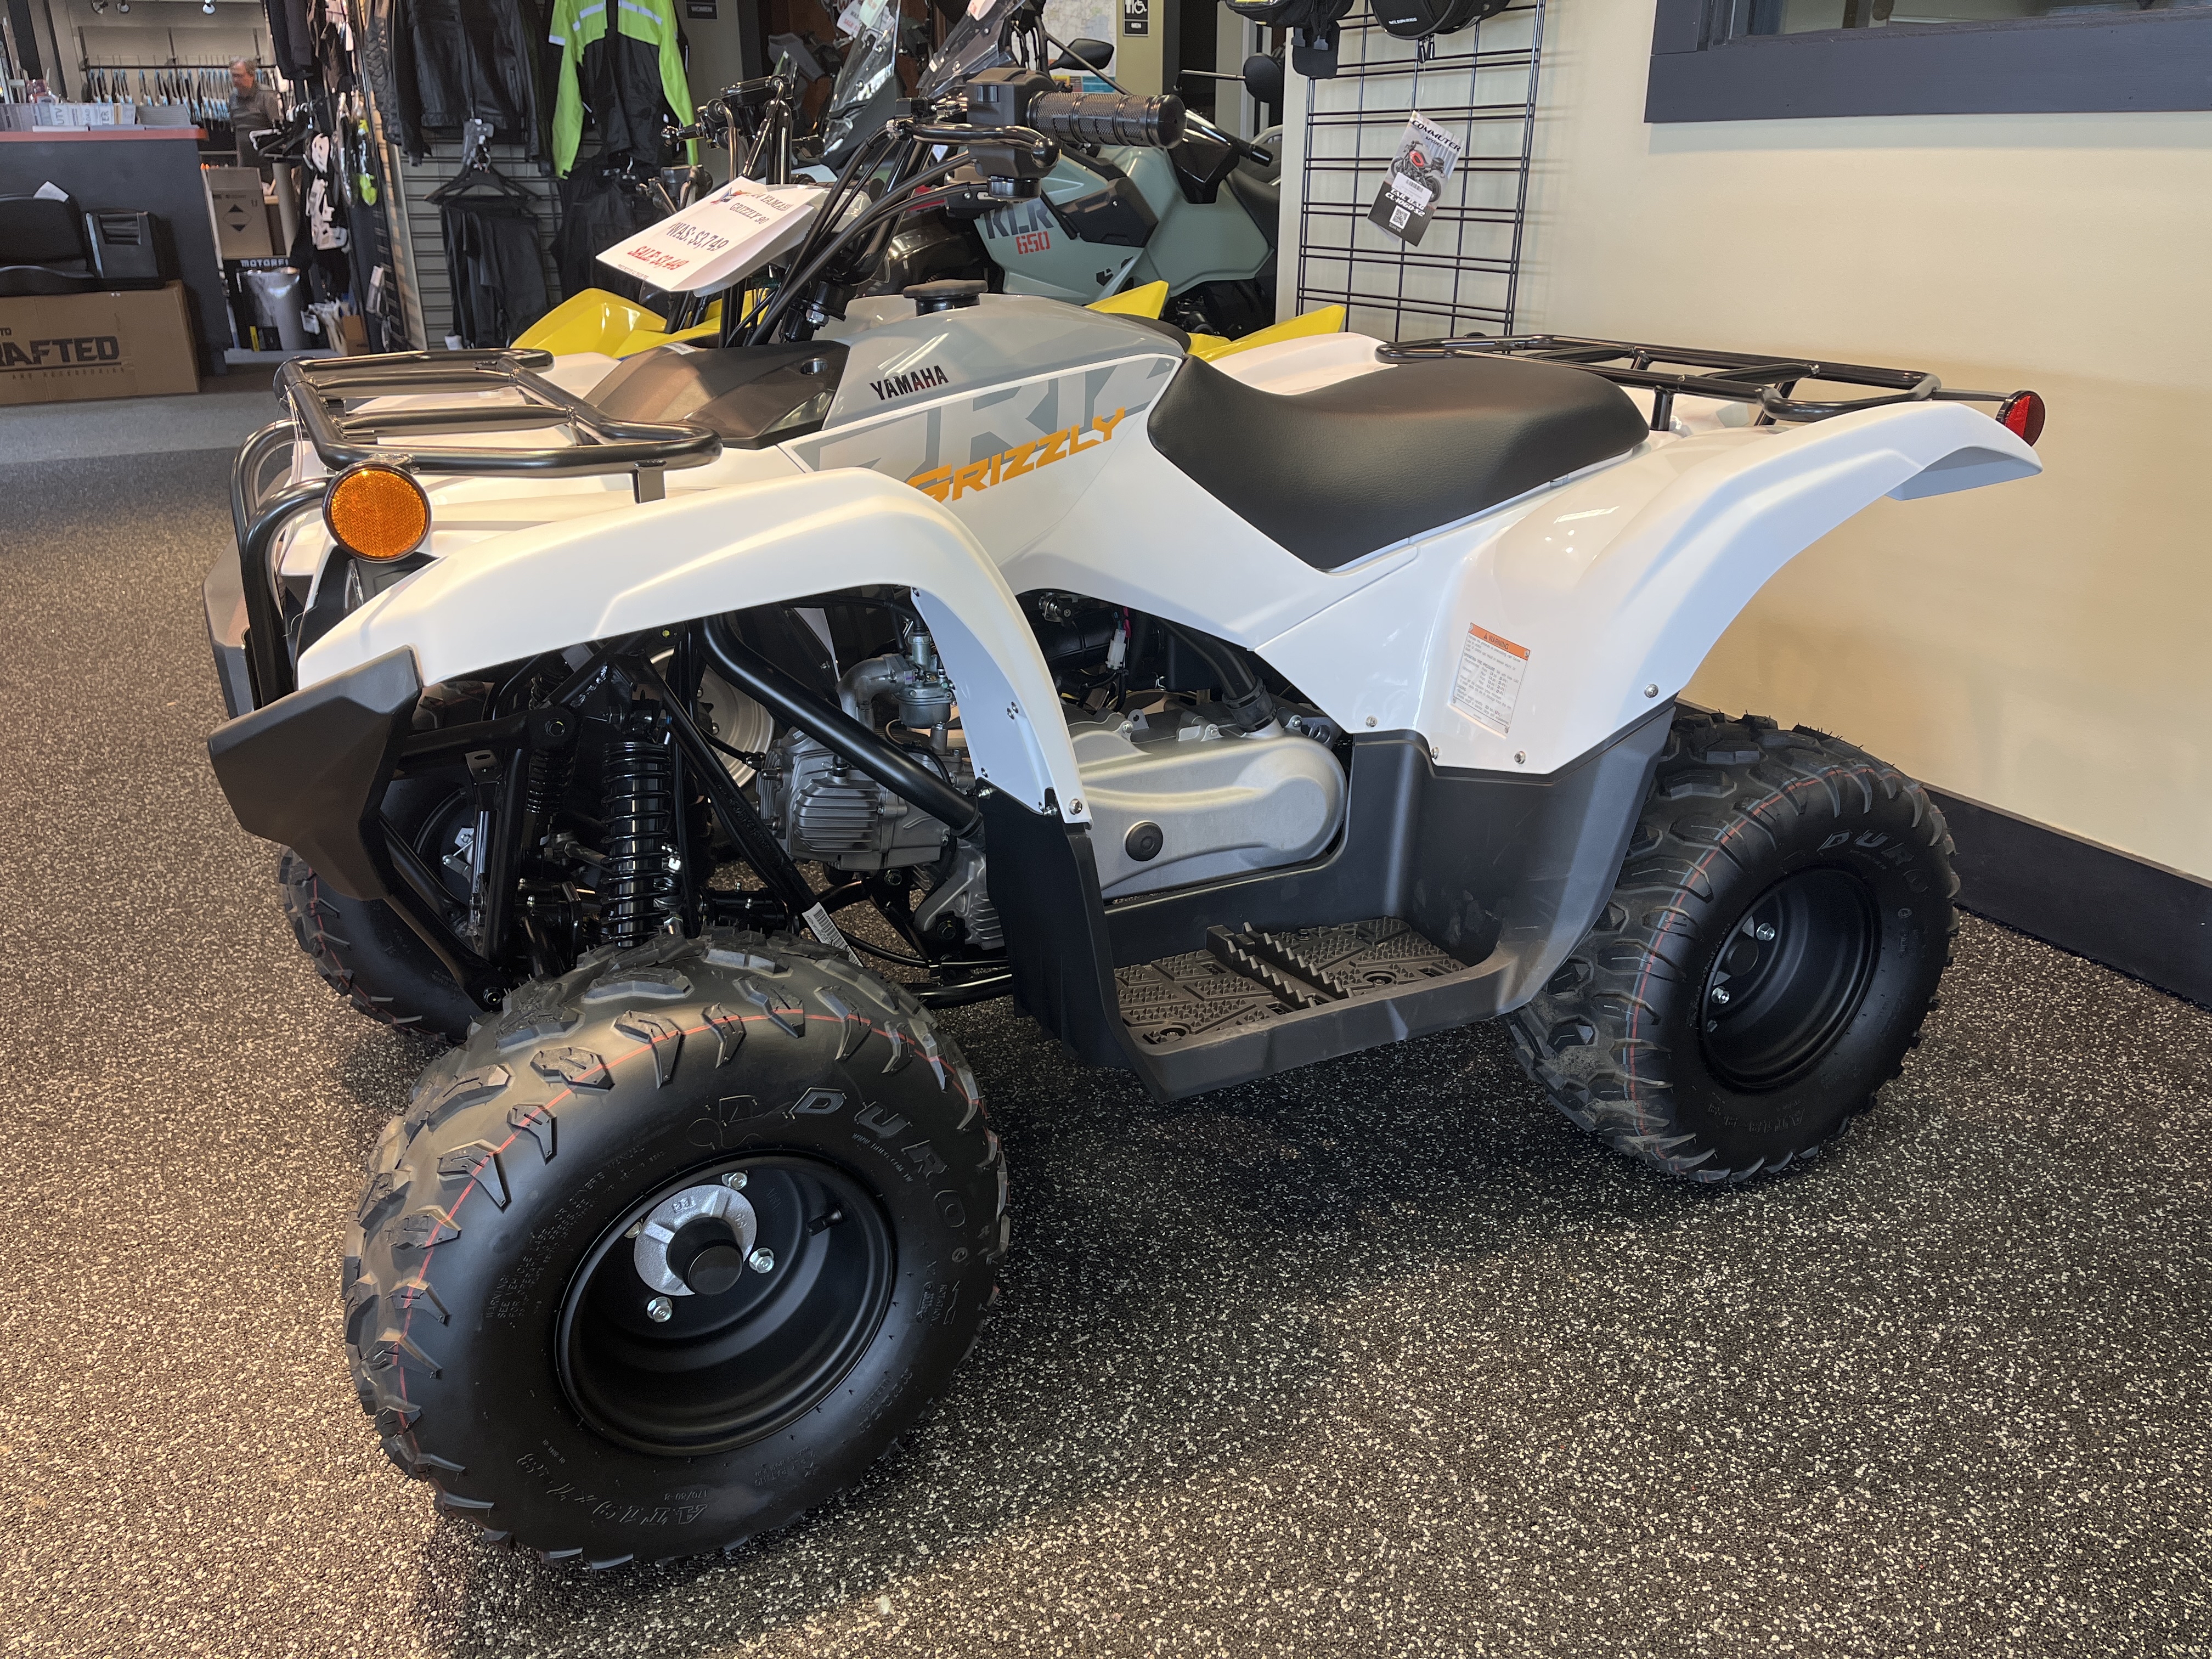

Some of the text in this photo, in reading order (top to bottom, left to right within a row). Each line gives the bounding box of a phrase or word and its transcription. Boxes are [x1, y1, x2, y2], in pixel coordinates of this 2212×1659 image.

[1412, 120, 1461, 152] COMMUTER
[1425, 136, 1442, 148] SPORT
[730, 202, 763, 219] GRIZZLY
[1385, 191, 1425, 217] CL-1060-S2
[981, 197, 1054, 239] KLR
[667, 222, 729, 251] WAS: $3,749
[1016, 231, 1051, 255] 650
[870, 365, 949, 401] YAMAHA
[903, 407, 1126, 503] GRIZZLY
[1489, 635, 1509, 650] WARNING
[788, 1086, 966, 1228] DURO
[498, 1301, 511, 1318] SEE
